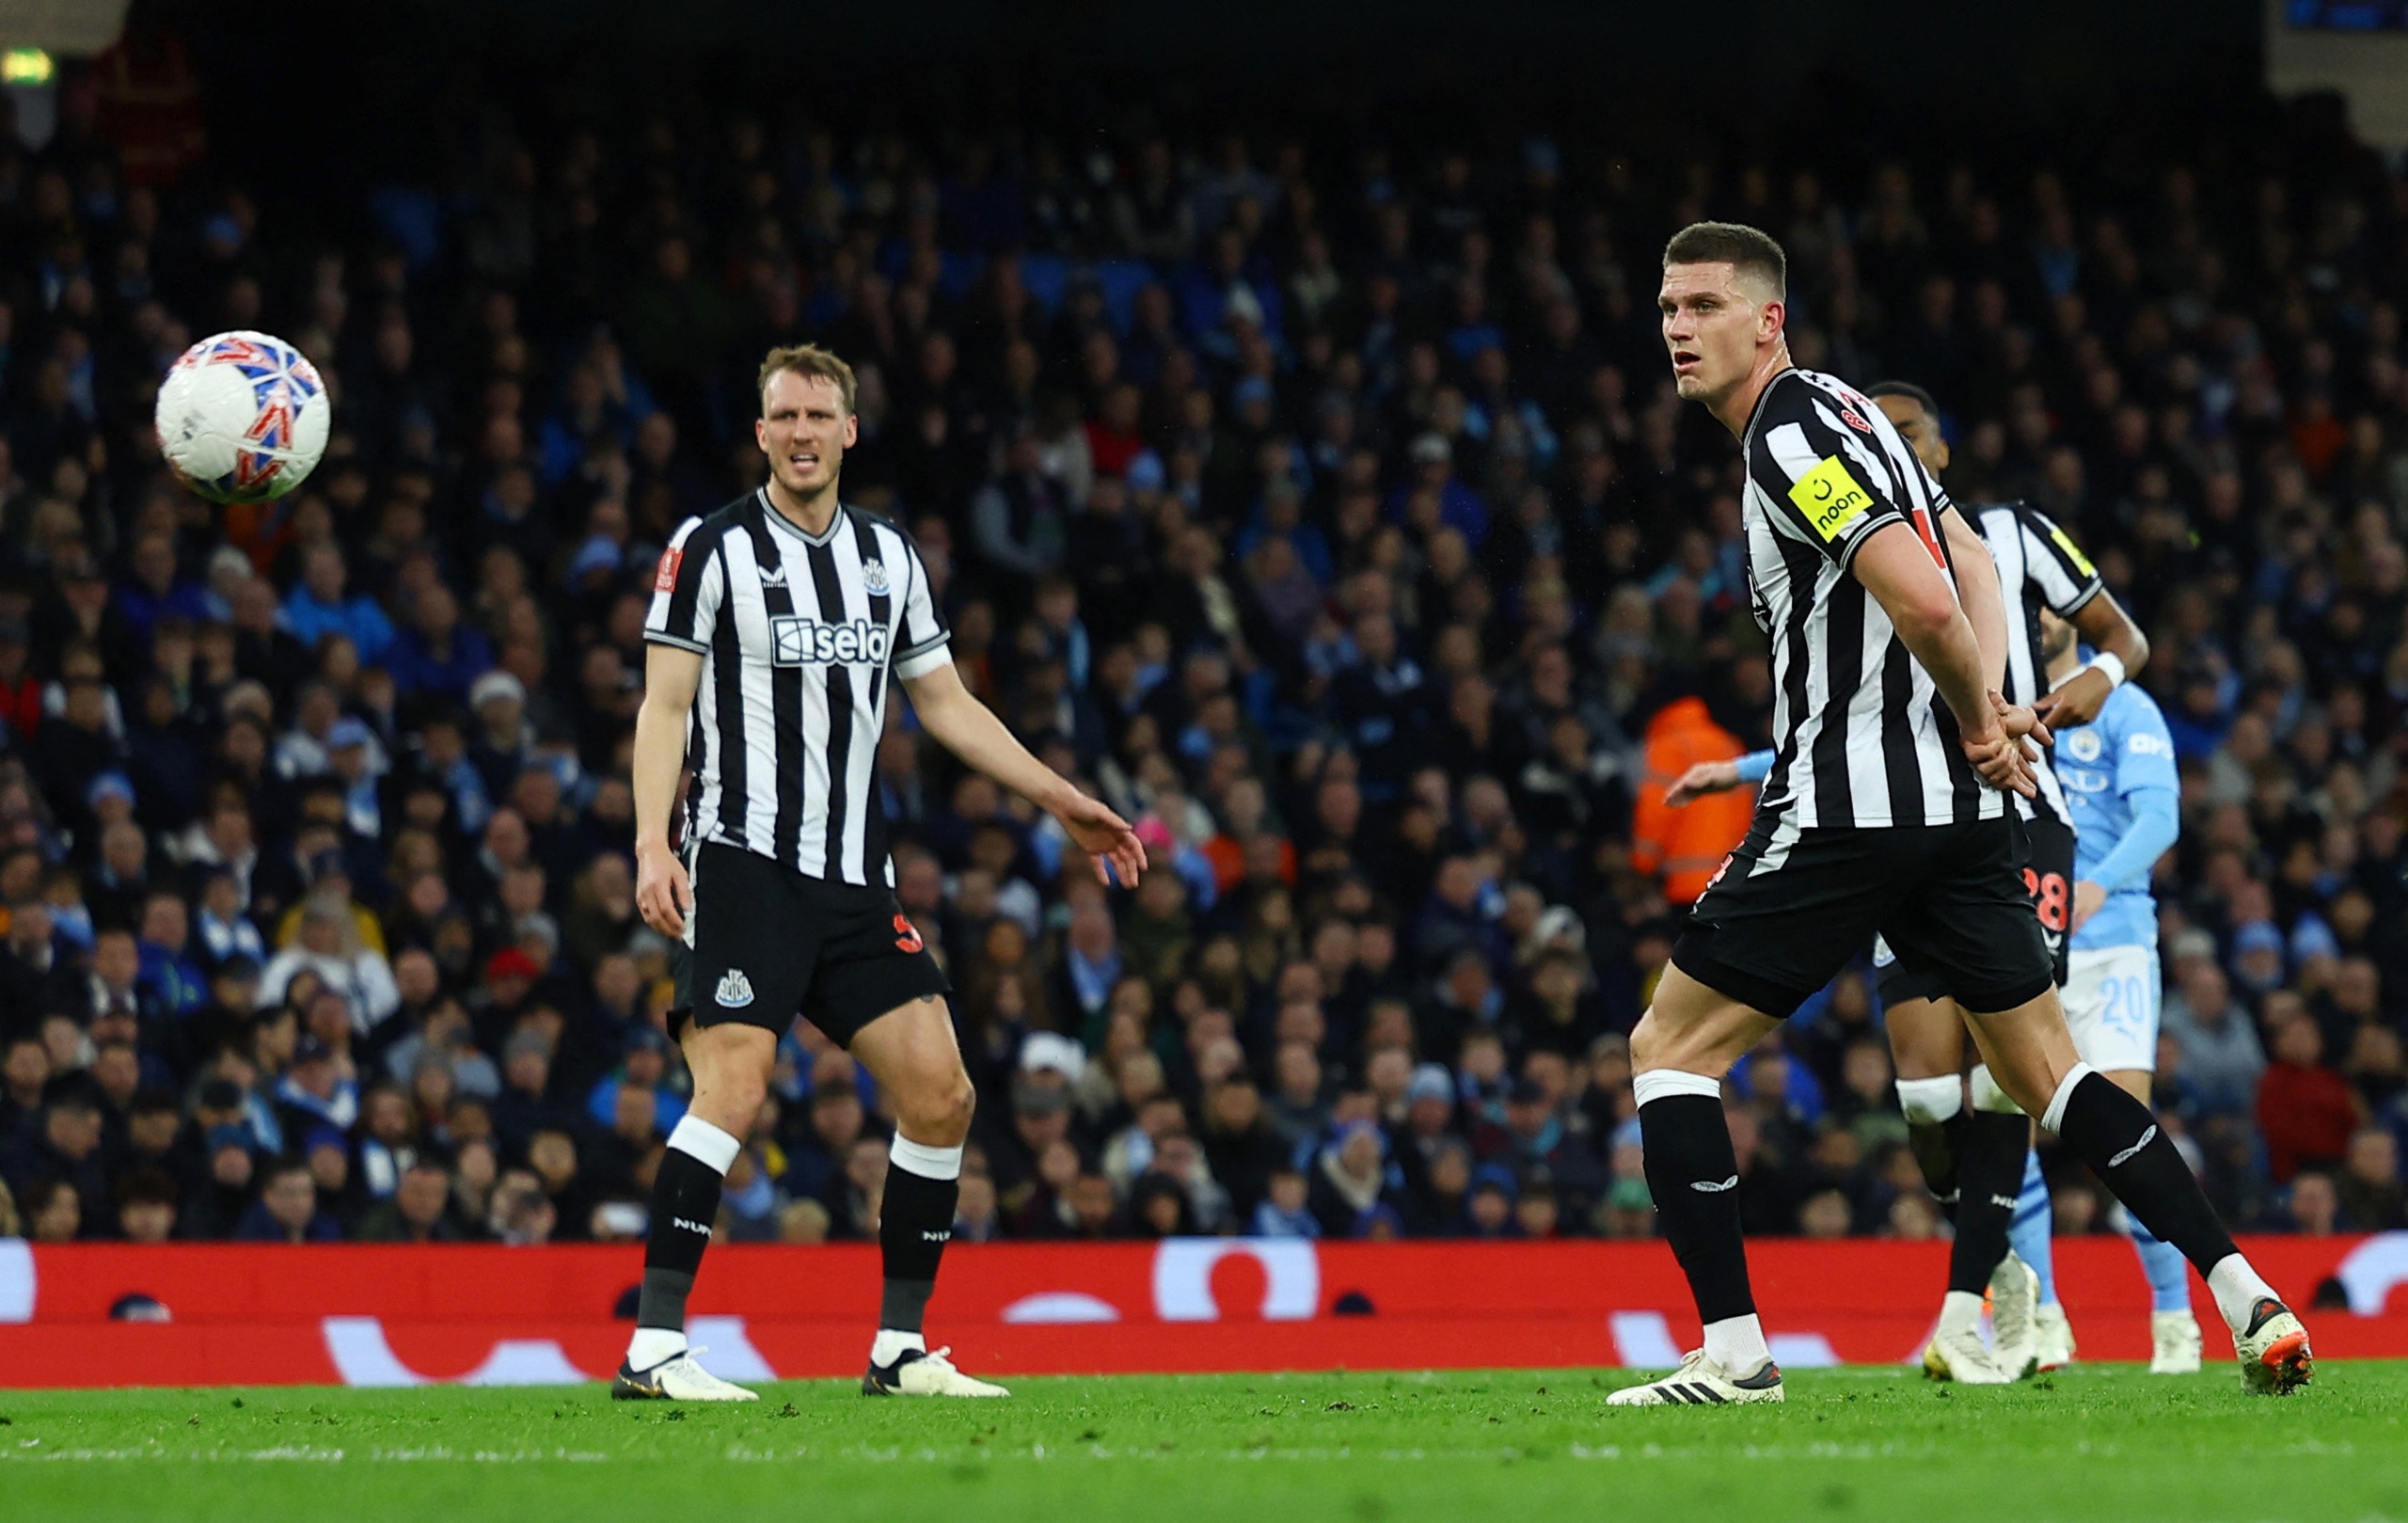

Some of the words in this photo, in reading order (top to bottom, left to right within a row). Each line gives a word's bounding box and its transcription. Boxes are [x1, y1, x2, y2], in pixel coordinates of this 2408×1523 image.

[1818, 491, 1862, 531] noon
[816, 620, 887, 662] sela
[2099, 976, 2144, 1023] 20
